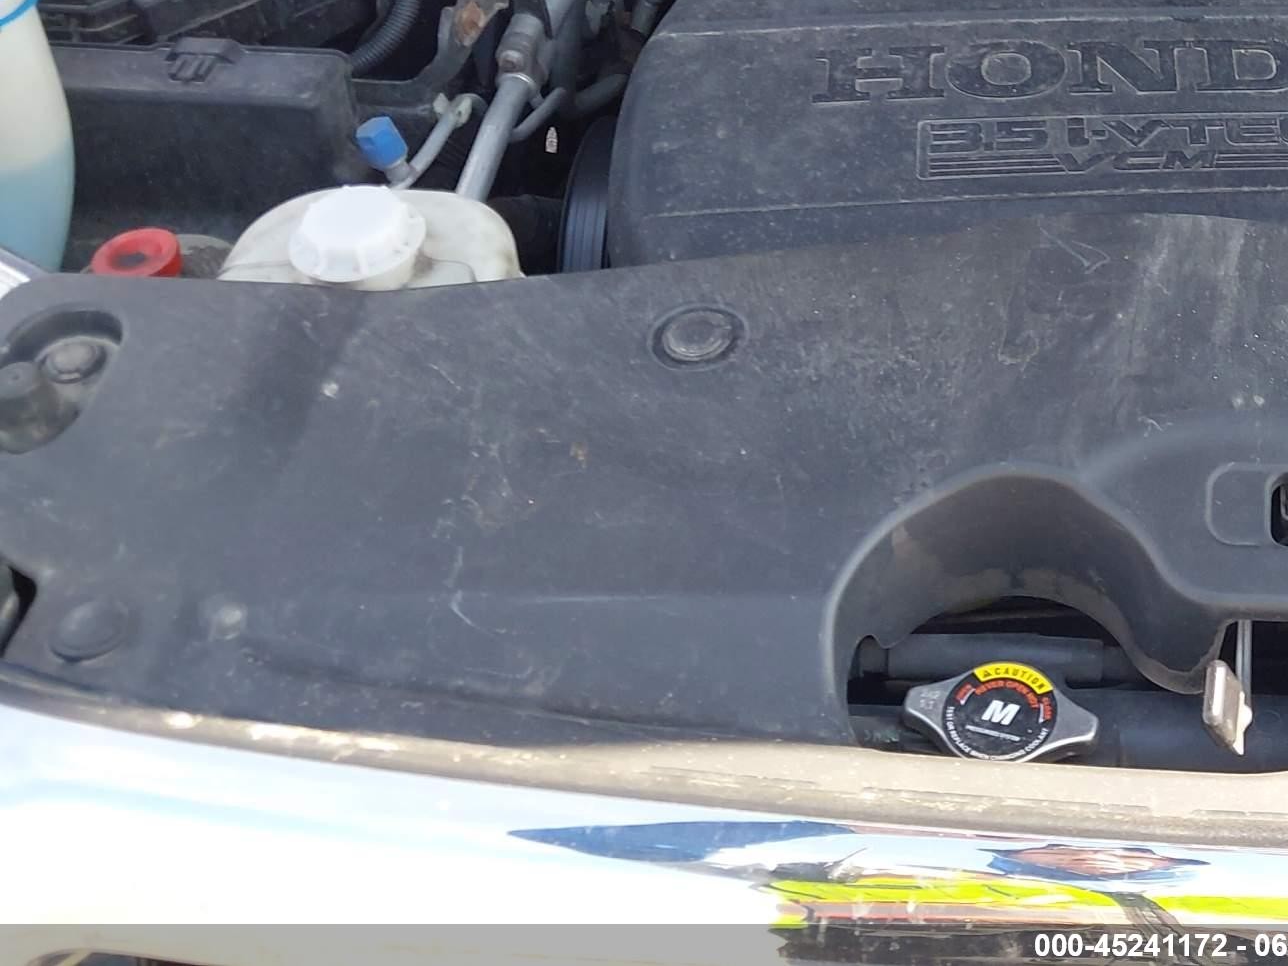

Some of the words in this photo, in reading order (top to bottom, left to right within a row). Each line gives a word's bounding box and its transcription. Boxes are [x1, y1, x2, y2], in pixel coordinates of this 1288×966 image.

[1057, 150, 1218, 174] VCM
[994, 667, 1046, 690] CAUTION
[980, 699, 1021, 726] M
